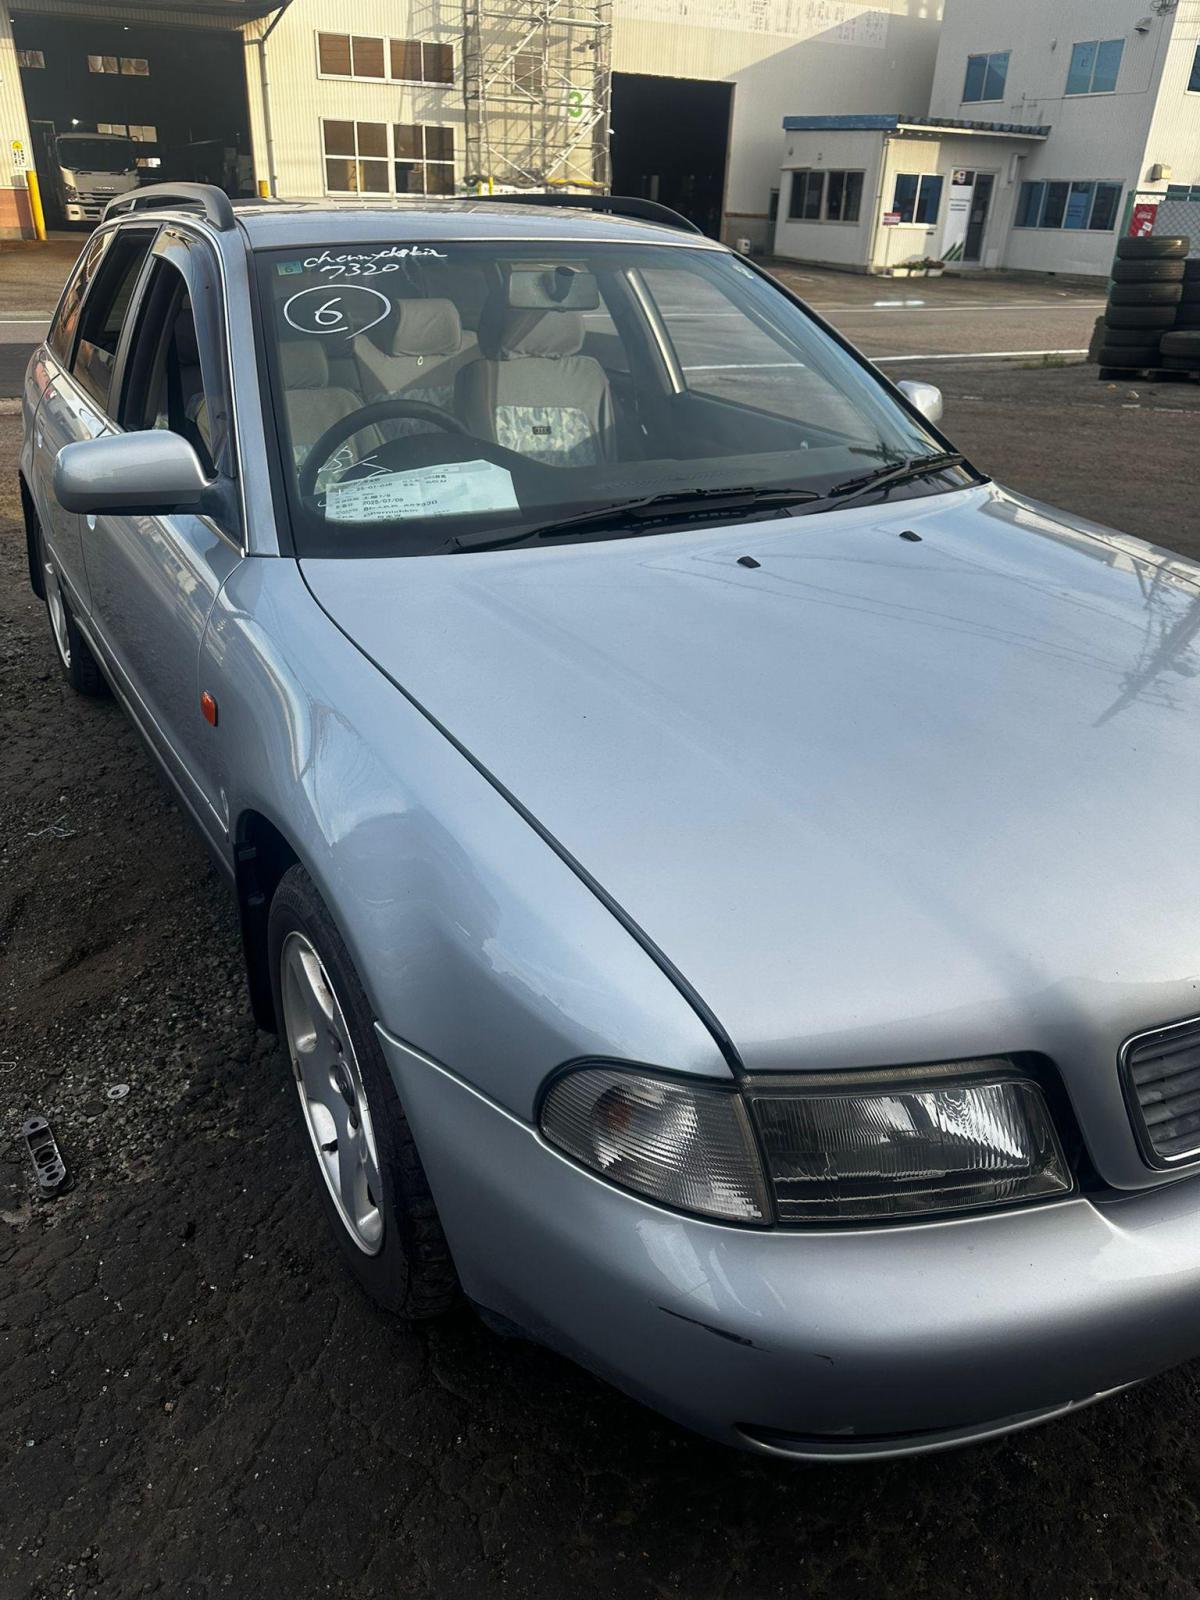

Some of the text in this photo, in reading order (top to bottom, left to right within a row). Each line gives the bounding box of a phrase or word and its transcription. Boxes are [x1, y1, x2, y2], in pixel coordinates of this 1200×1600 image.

[567, 91, 583, 118] 3
[320, 263, 399, 280] 7320
[314, 297, 343, 325] 6
